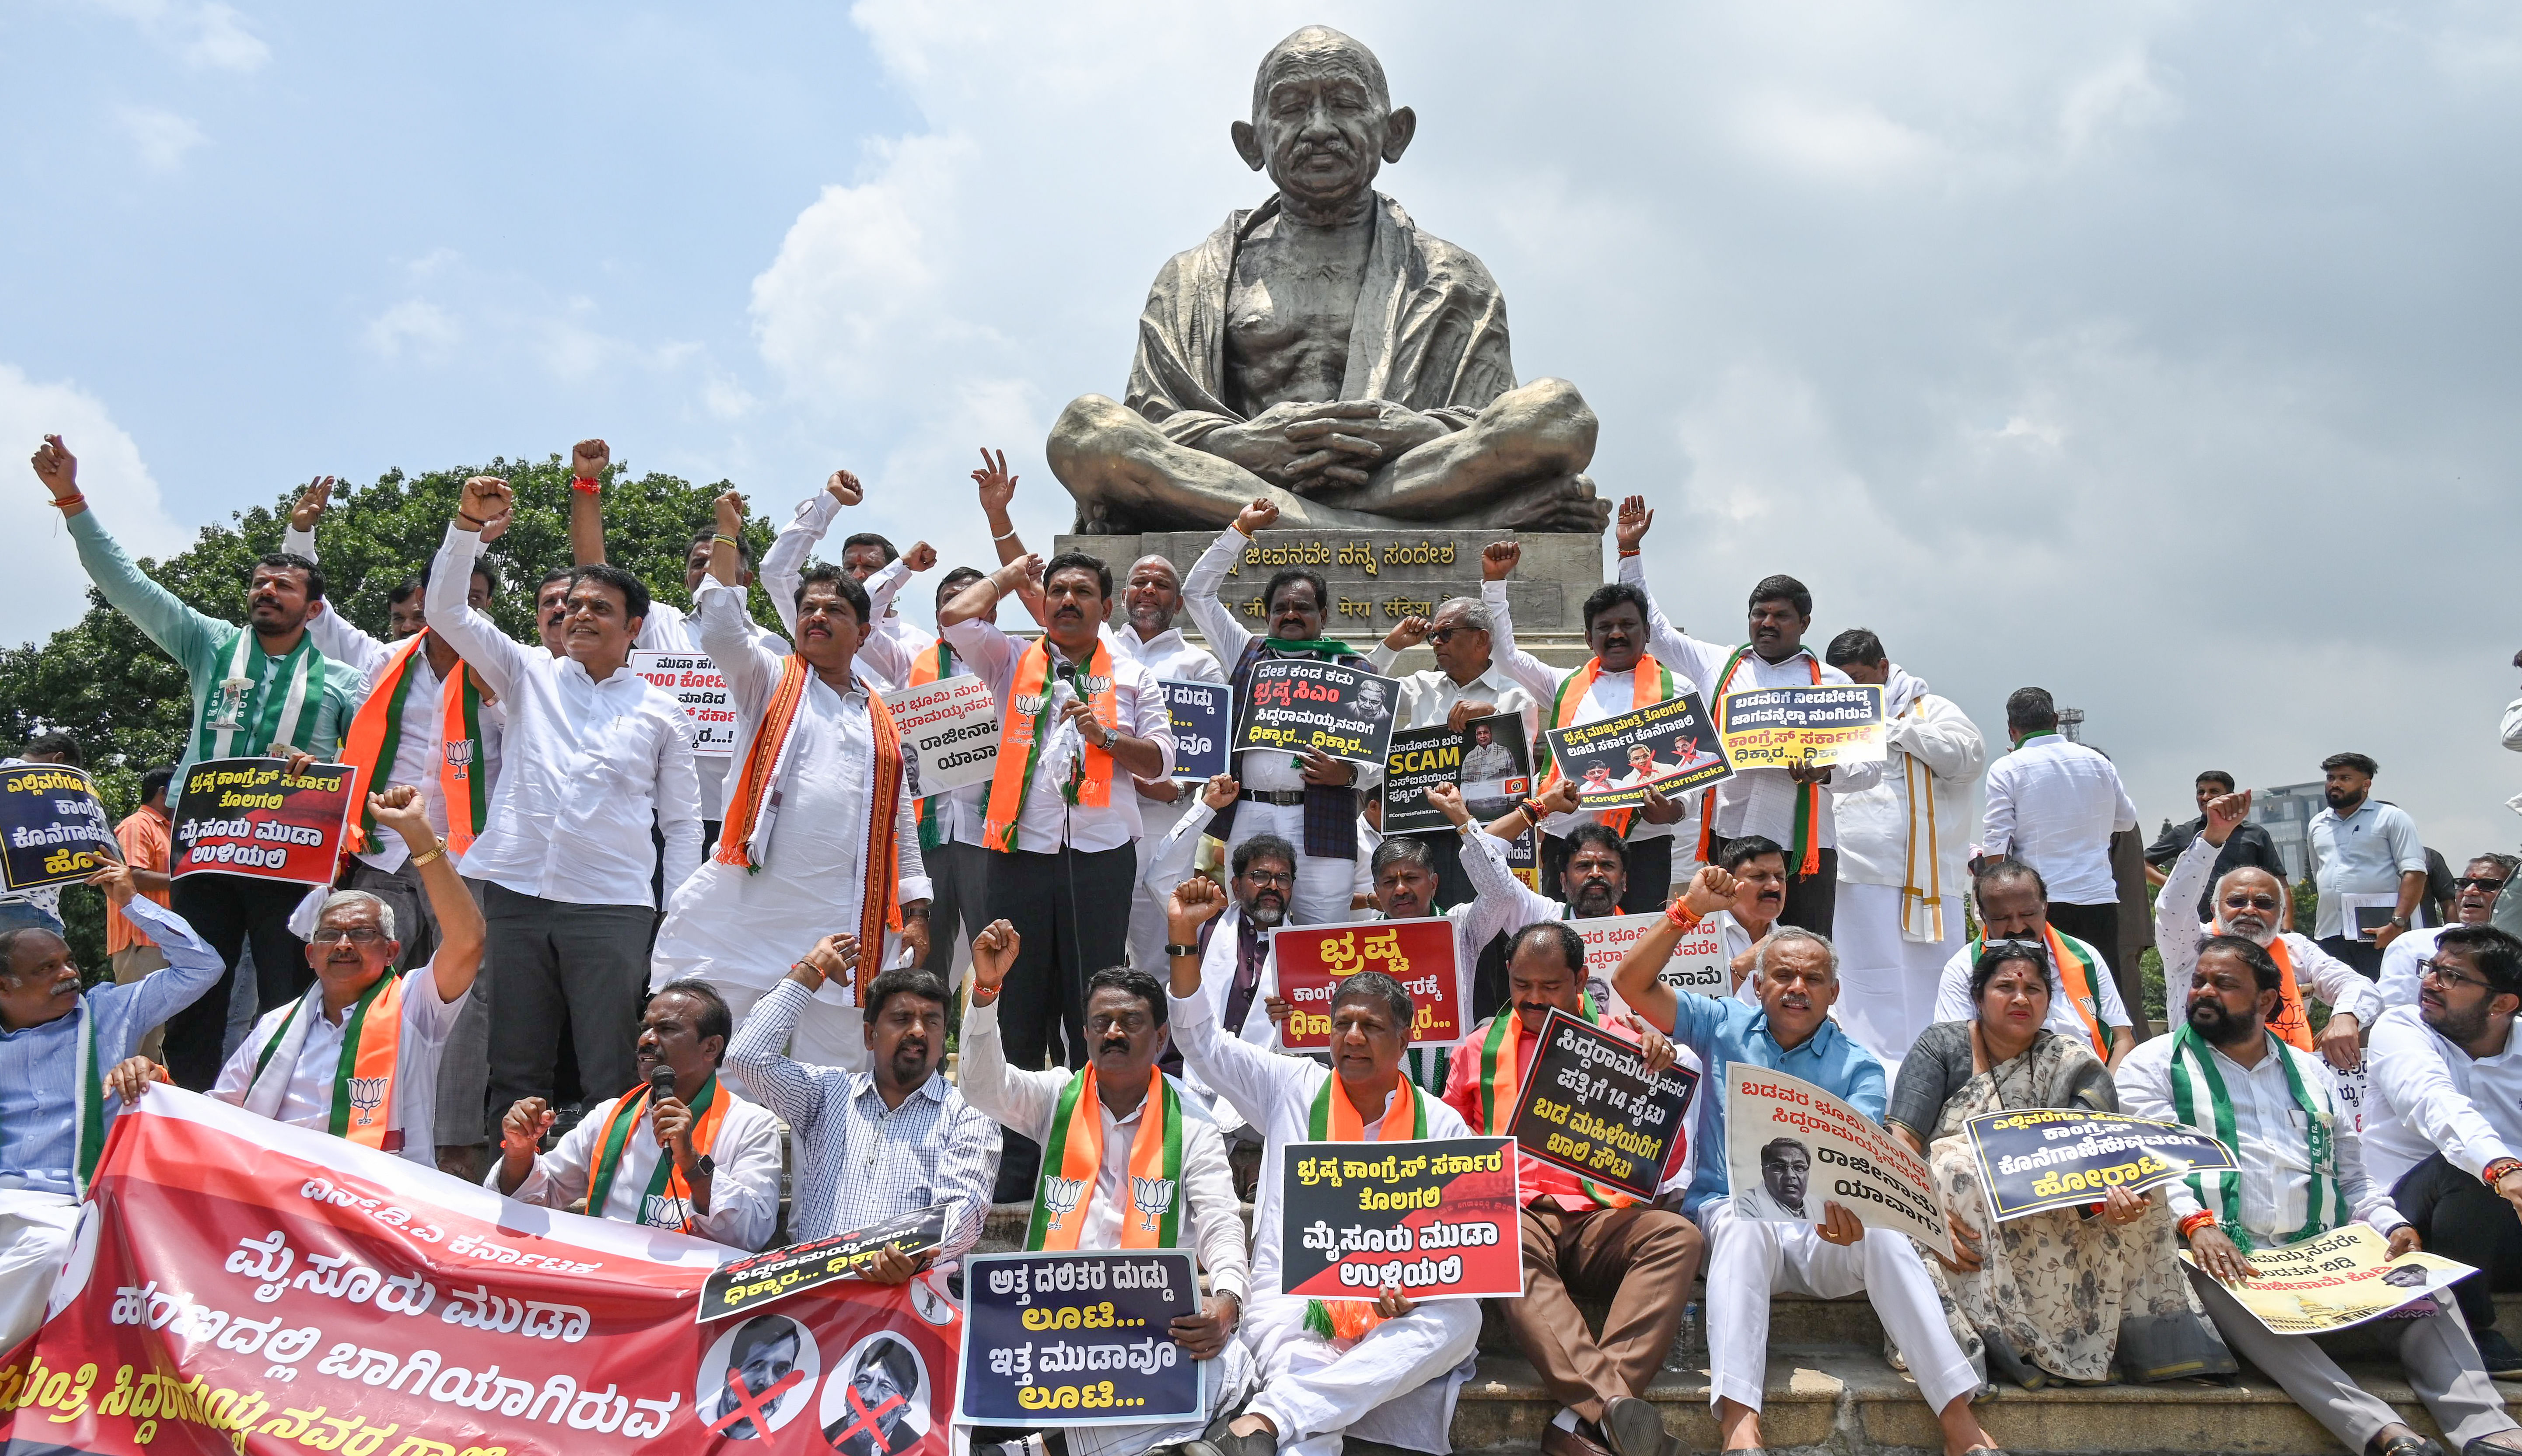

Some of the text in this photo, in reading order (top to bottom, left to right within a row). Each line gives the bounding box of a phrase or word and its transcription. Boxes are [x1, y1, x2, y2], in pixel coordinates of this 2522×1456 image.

[1245, 541, 1455, 576] ಜೀವನವೇ ನನ್ನ ಸಂದೇಶ
[1338, 596, 1372, 618] मेरा
[1383, 596, 1431, 617] संदेश
[656, 657, 693, 669] ಮುಡಾ
[1259, 665, 1355, 685] ದೇಶ ಕಂಡ ಕಡು
[636, 673, 676, 687] 000
[1253, 678, 1340, 706] ಭ್ರಷ್ಟ ಸಿಎಂ
[678, 692, 726, 705] ಮಾಡಿದ
[909, 691, 950, 713] ಭೂಮಿ
[1174, 685, 1215, 715] ದುಡ್ಡು
[1735, 689, 1870, 709] ಬಡವರಿಗೆ ನೀಡಬೇಕಿದ್ದ
[1563, 700, 1687, 745] ಭ್ರಷ್ಟ ಮುಖ್ಯಮಂತ್ರಿ ತೊಲಗಲಿ
[1731, 705, 1872, 726] ಜಾಗವನ್ನೆಲ್ಲಾ ನುಂಗಿರುವ
[1248, 726, 1372, 755] ಧಿಕ್ಕಾರ... ಧಿಕ್ಕಾರ...
[1389, 734, 1463, 754] ಮಾಡೋದು ಬರೀ
[1567, 714, 1695, 757] ಲೂಟಿ ಸರ್ಕಾರ ಕೊನೆಗಾಣಲಿ
[1728, 730, 1795, 748] ಕಾಂಗ್ರೆಸ್
[1389, 746, 1460, 774] SCAM
[7, 772, 84, 796] ಎಲ್ಲಿವರೆಗೂ
[190, 767, 342, 794] ಭ್ರಷ್ಟ ಕಾಂಗ್ರೆಸ್ ಸರ್ಕಾರ
[1512, 782, 1522, 790] SIT
[218, 790, 284, 810] ತೊಲಗಲಿ
[1389, 809, 1441, 818] #CongressFailsKarn
[178, 816, 323, 848] ಮೈಸೂರು ಮುಡಾ
[191, 842, 287, 869] ಉಳಿಯಲಿ
[1320, 929, 1410, 976] ಭ್ರಷ್ಟ
[1557, 1066, 1666, 1127] ಪತ್ನಿಗೆ 14 ಸೈಟು
[1533, 1097, 1662, 1161] ಬಡ ಮಹಿಳೆಯರಿಗೆ
[1742, 1081, 1927, 1179] ಬಡವರ ಭೂಮಿ ನುಂಗಿದ
[1993, 1111, 2085, 1131] ಎಲ್ಲಿವರೆಗೂ
[2042, 1121, 2133, 1140] ಕಾಂಗ್ರೆಸ್
[1297, 1150, 1502, 1187] ಭ್ರಷ್ಟ ಕಾಂಗ್ರೆಸ್ ಸರ್ಕಾರ
[1546, 1132, 1633, 1179] ಖಾಲಿ ಸೌಟು
[1818, 1146, 1938, 1218] ರಾಜೀನಾಮೆ
[1359, 1186, 1441, 1211] ತೊಲಗಲಿ
[1834, 1179, 1942, 1236] ಯಾವಾಗ?
[448, 1234, 604, 1274] ಕರ್ನಾಟಕ
[1302, 1220, 1498, 1261] ಮೈಸೂರು ಮುಡಾ
[1339, 1255, 1462, 1288] ಉಳಿಯಲಿ
[2319, 1257, 2356, 1271] ಬಿಡಿ
[225, 1230, 591, 1343] ಮೈಸೂರು ಮುಡಾ
[989, 1260, 1175, 1306] ಅತ್ತ ದಲಿತರ ದುಡ್ಡು
[2245, 1276, 2345, 1290] ರಾಜೀನಾಮೆ
[1021, 1301, 1145, 1331] ಲೂಟಿ...
[989, 1337, 1177, 1386] ಇತ್ತ ಮುಡಾವೂ
[316, 1342, 681, 1439] ಬಾಗಿಯಾಗಿರುವ
[1018, 1380, 1145, 1410] ಲೂಟಿ...
